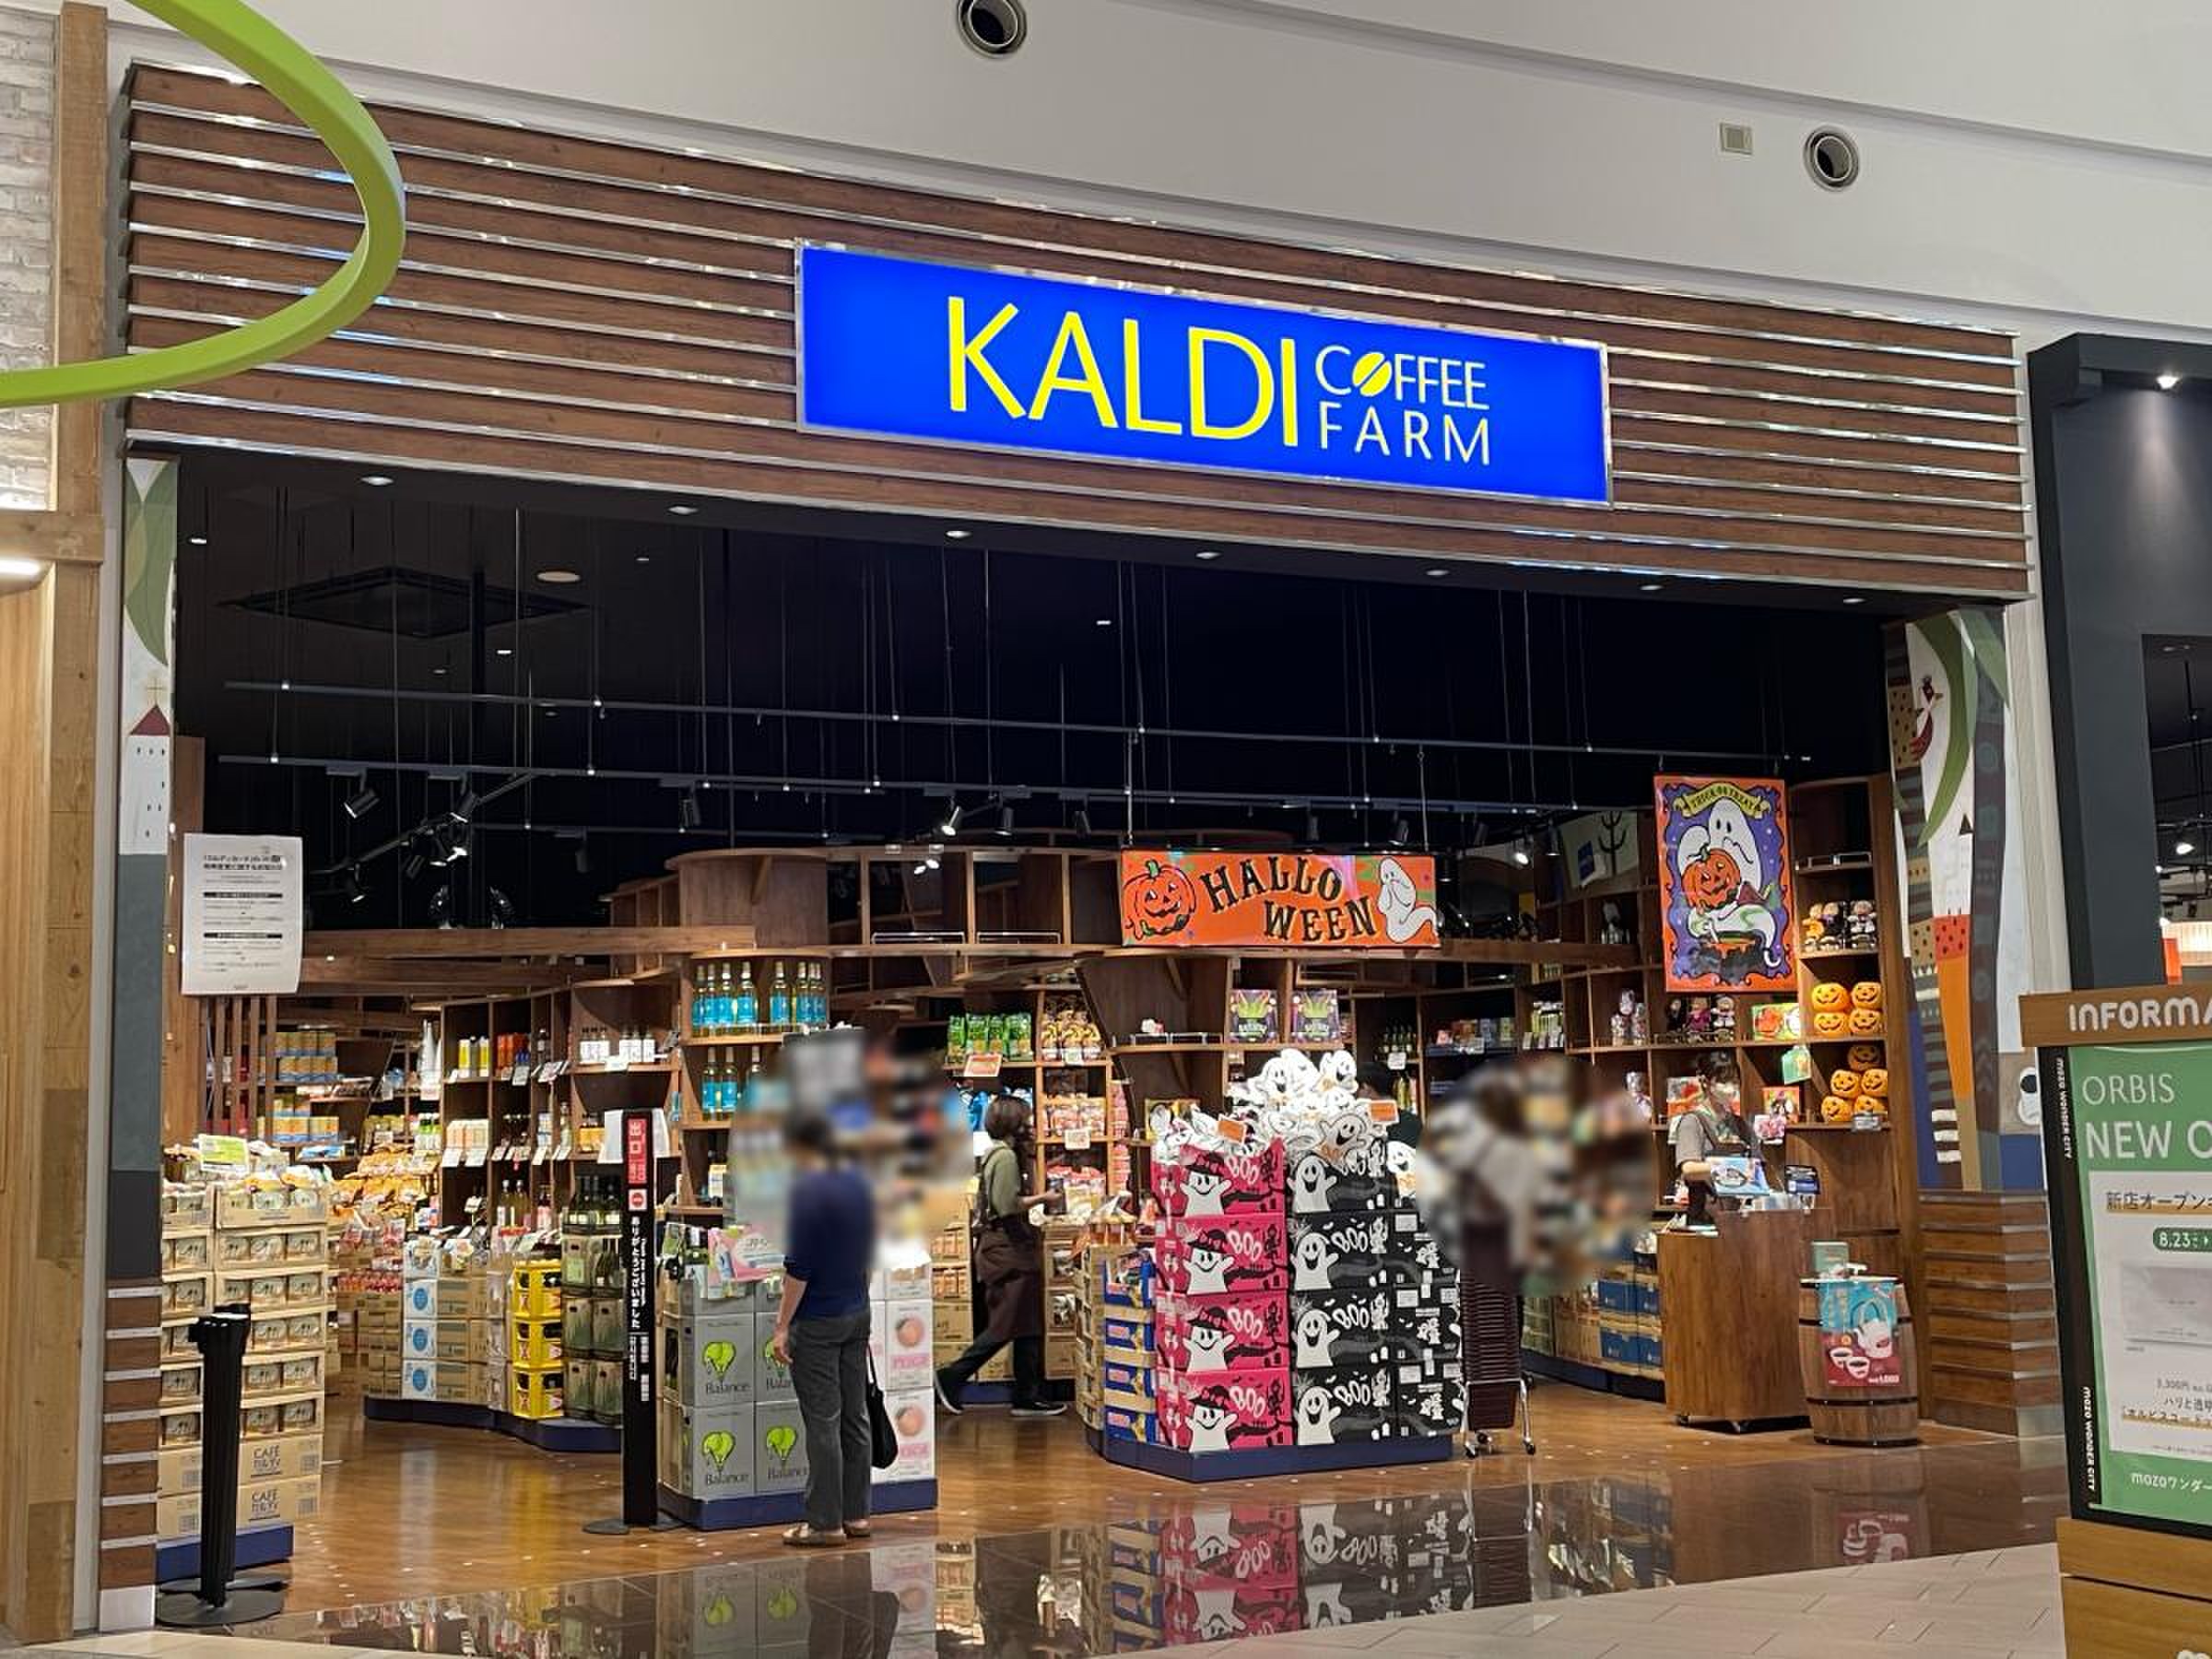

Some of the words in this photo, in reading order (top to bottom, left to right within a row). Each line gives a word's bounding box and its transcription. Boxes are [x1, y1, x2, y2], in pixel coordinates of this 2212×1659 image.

[947, 295, 1299, 447] KALDI
[1315, 344, 1488, 411] COFFEE
[1319, 406, 1491, 466] FARM
[1199, 855, 1343, 913] HALLO
[1264, 895, 1378, 942] WEEN
[2081, 1074, 2176, 1106] ORBIS
[2085, 1120, 2172, 1159] NEW
